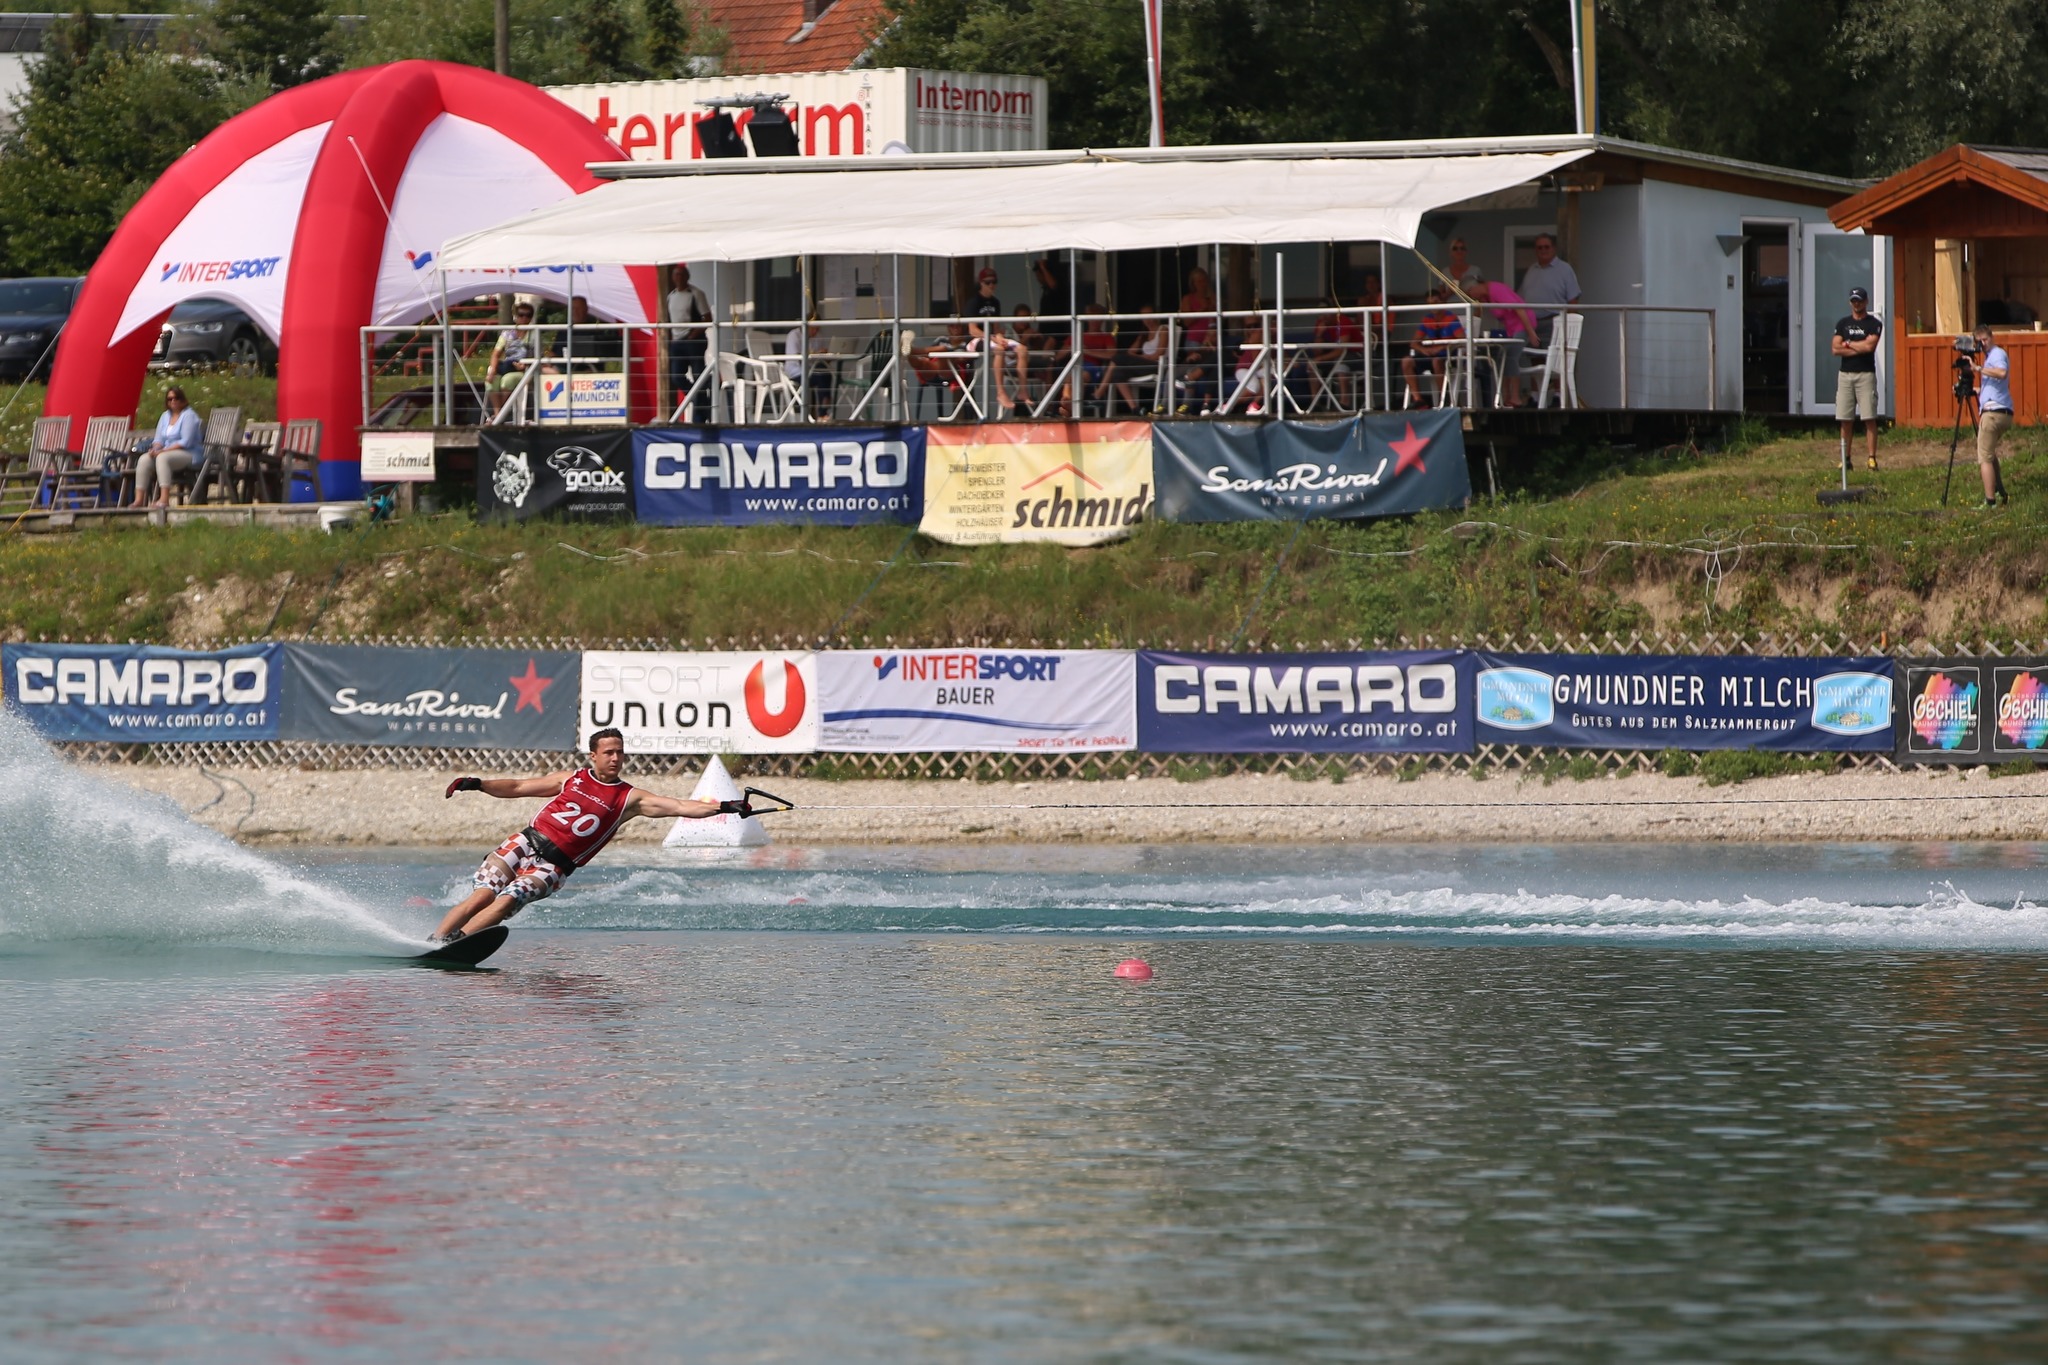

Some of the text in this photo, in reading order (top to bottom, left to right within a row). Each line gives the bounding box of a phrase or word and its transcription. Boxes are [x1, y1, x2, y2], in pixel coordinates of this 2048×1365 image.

[917, 77, 1032, 115] Internorm
[178, 257, 282, 282] INTERSPORT
[570, 380, 621, 391] NTERSPORT
[571, 391, 619, 402] MUNDEN
[386, 452, 430, 467] schmid
[644, 440, 909, 489] CAMARO
[968, 476, 1006, 487] SPENGLER
[1201, 457, 1388, 493] SansRival
[745, 494, 910, 511] www.camaro.at
[957, 490, 1005, 500] DACHDECKER
[1012, 483, 1149, 528] schmid
[1261, 492, 1366, 506] WATERSKI
[16, 656, 268, 705] CAMARO
[591, 665, 731, 694] SPORT
[903, 655, 1061, 681] INTERSPORT
[936, 687, 994, 705] BAUER
[1154, 663, 1457, 714] CAMARO
[1554, 673, 1811, 708] GMUNDNER MILCH
[330, 687, 508, 719] SansRival
[591, 702, 731, 727] union
[108, 709, 267, 728] www.camaro.at
[387, 721, 487, 733] WATERSKI
[1270, 721, 1457, 737] www.camaro.at
[551, 801, 600, 837] 20
